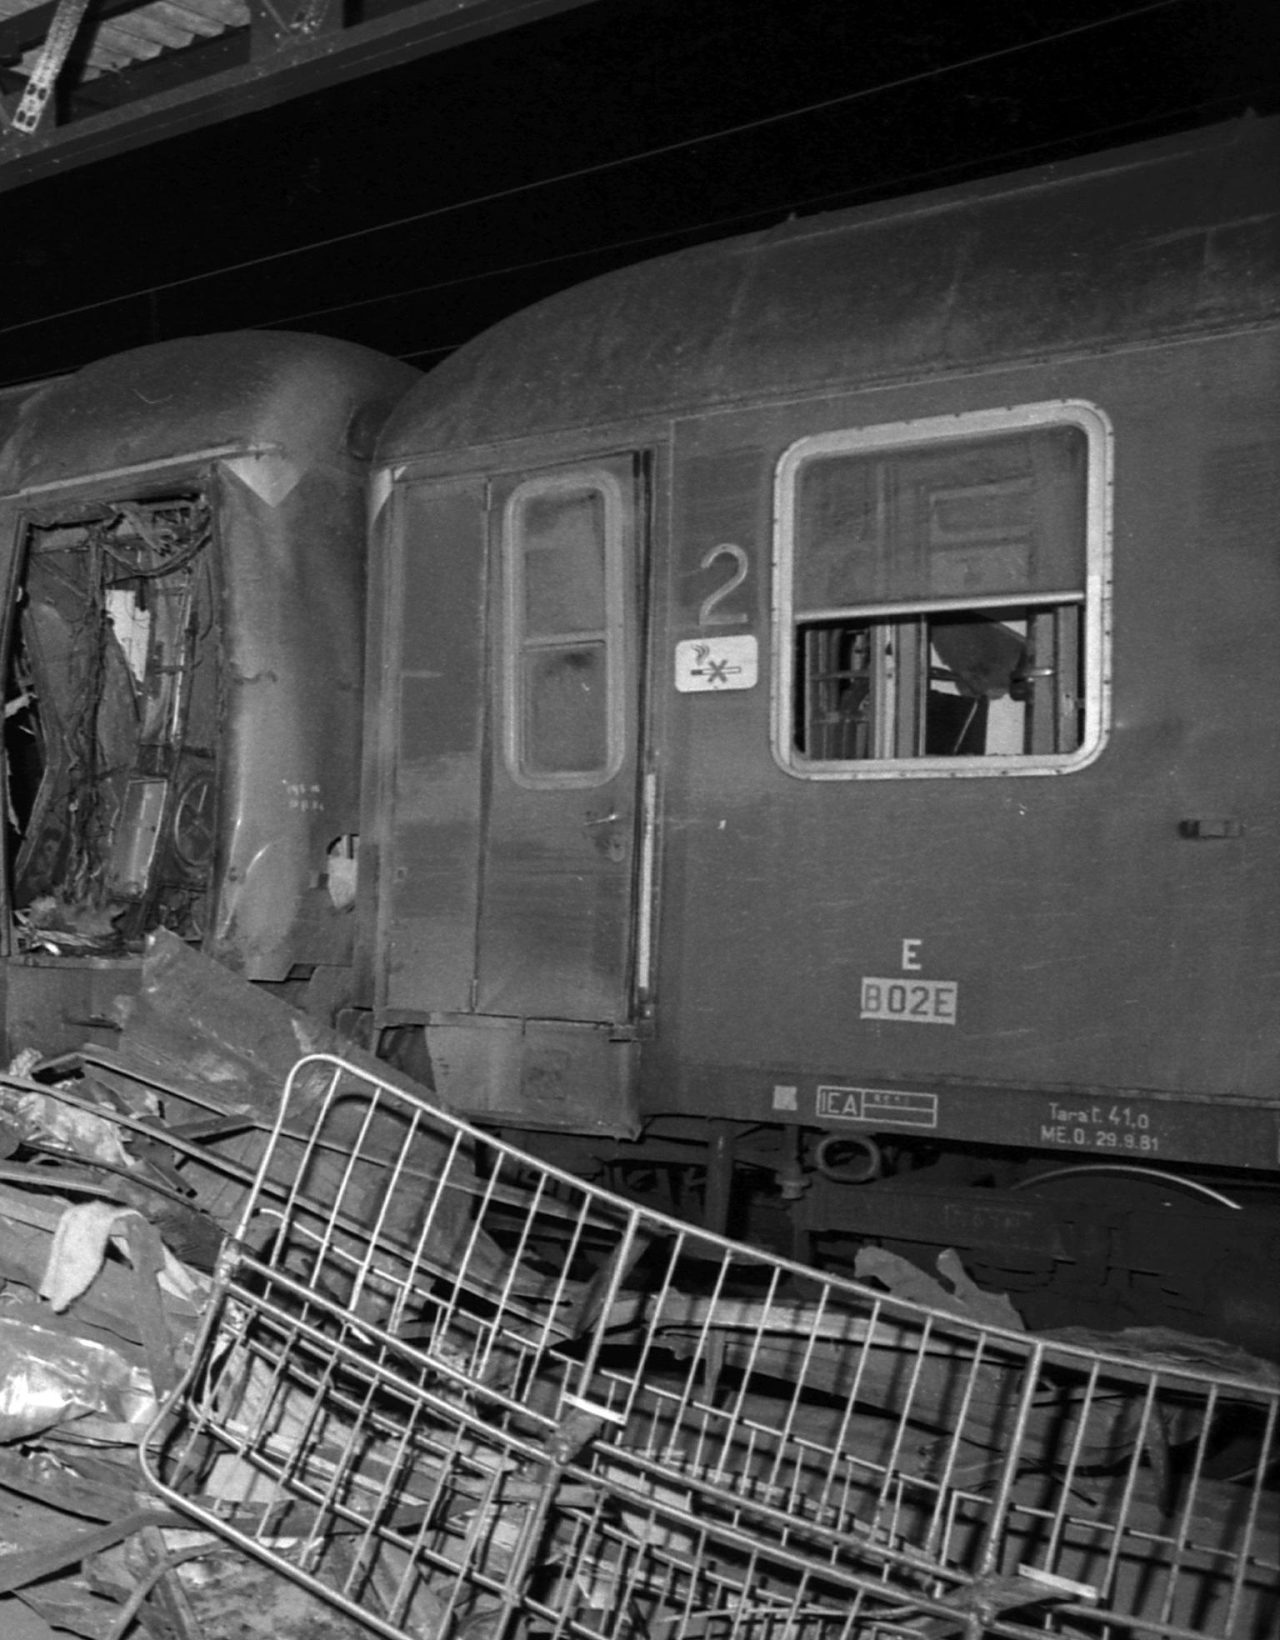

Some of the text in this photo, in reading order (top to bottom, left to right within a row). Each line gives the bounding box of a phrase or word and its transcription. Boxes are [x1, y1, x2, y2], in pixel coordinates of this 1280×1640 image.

[700, 544, 748, 624] 2
[903, 939, 922, 970] E
[1049, 1102, 1087, 1122] Tara
